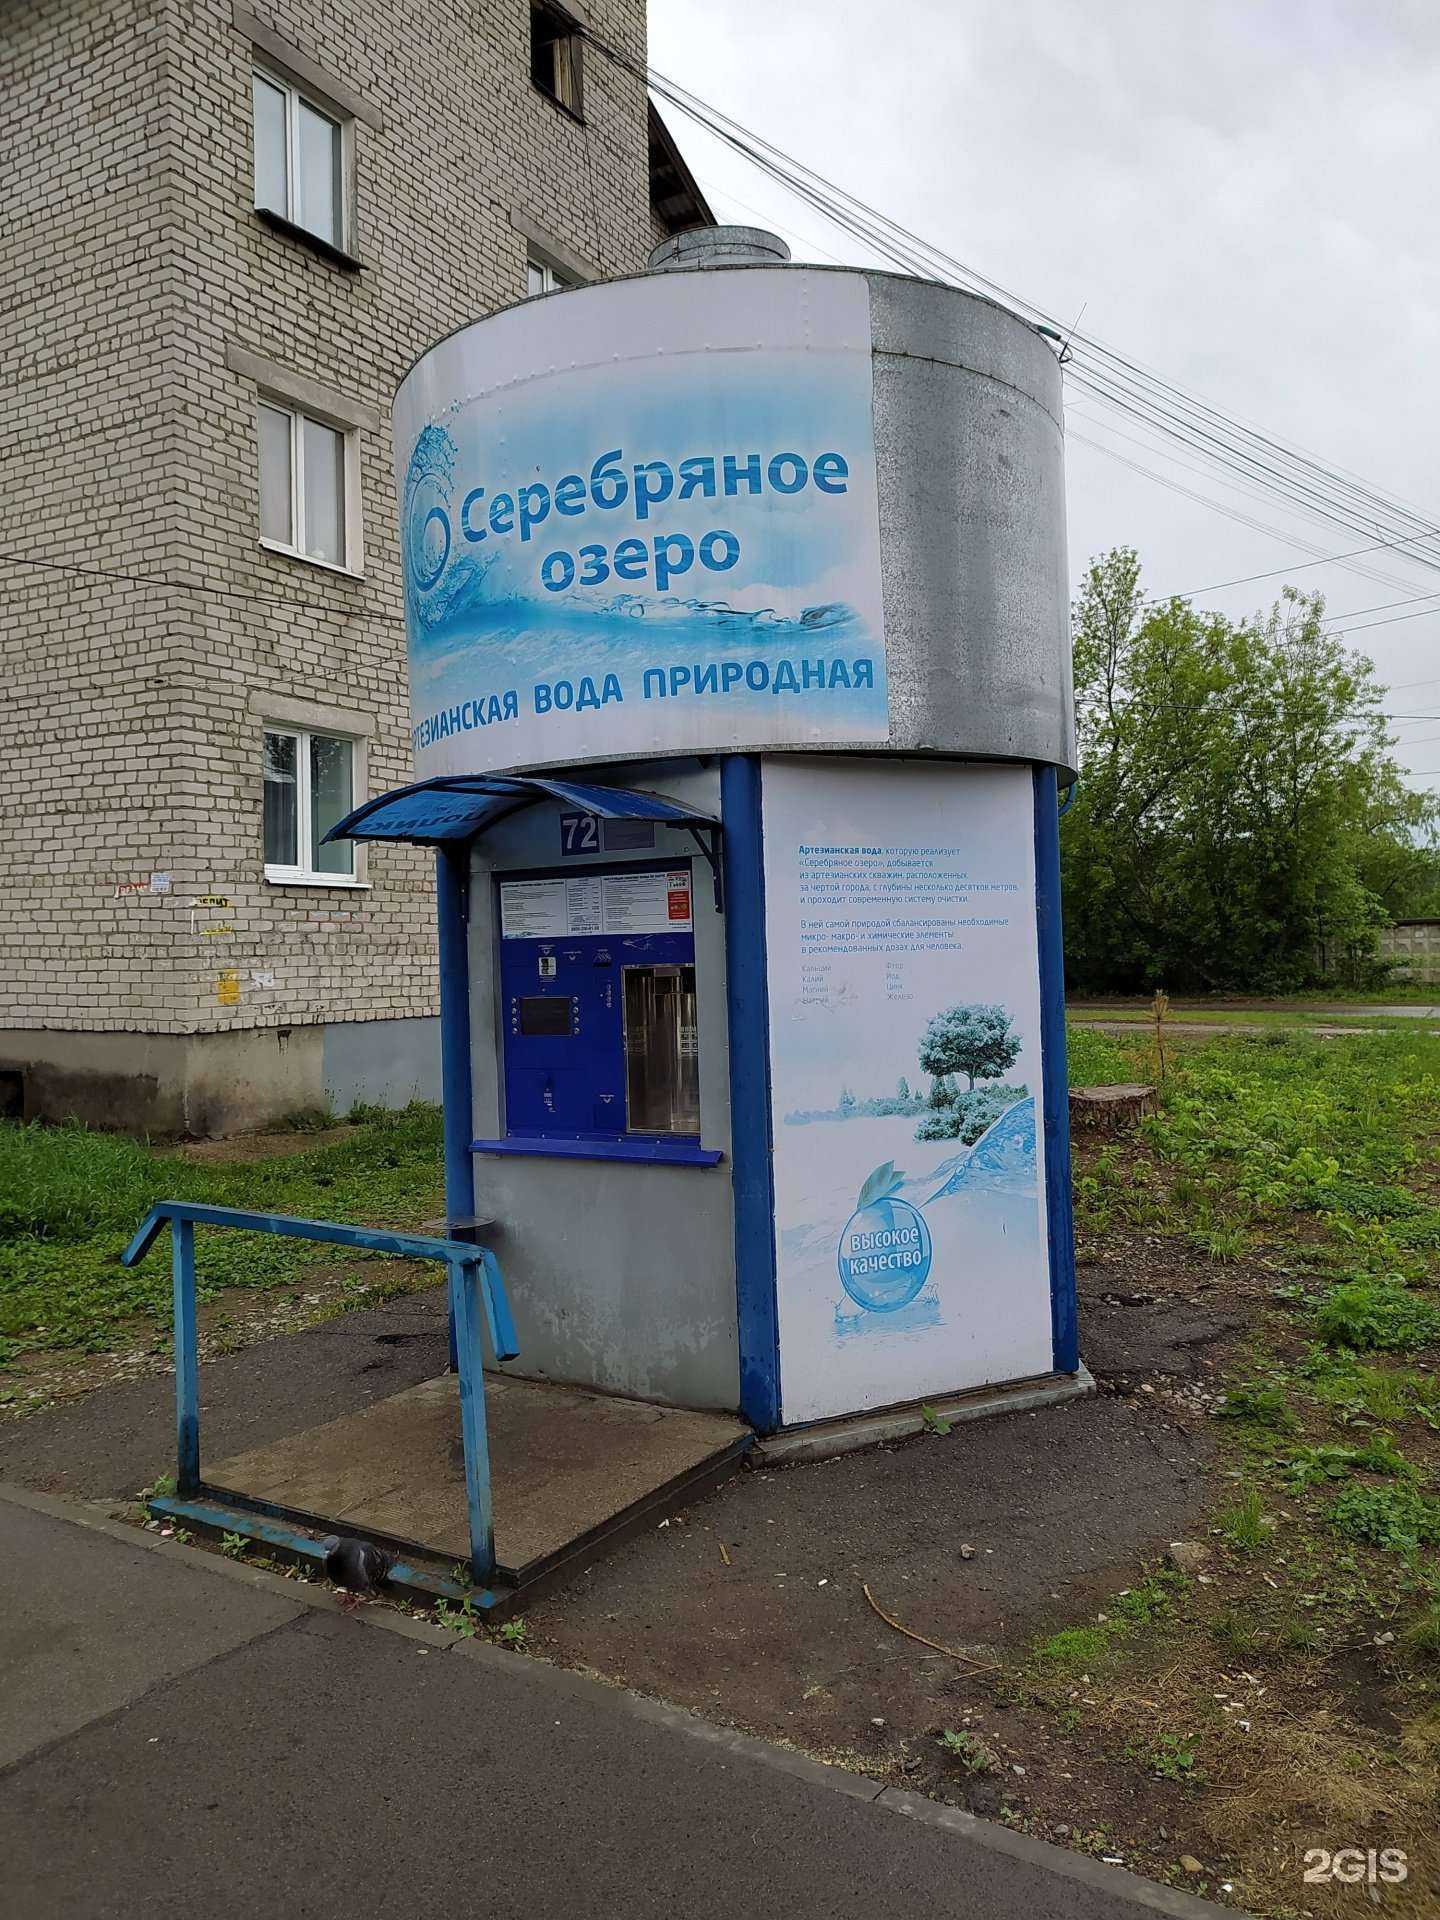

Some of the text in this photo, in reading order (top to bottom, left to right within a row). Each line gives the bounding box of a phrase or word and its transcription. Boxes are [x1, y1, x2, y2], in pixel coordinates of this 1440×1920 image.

[461, 449, 849, 542] Серебряное
[541, 529, 741, 592] озеро
[533, 673, 623, 714] ВОДА
[643, 658, 874, 699] ПРИРОДНАЯ
[562, 816, 597, 849] 72
[799, 846, 860, 856] Артезианская
[886, 847, 919, 857] которую
[920, 847, 961, 857] реализует
[807, 896, 846, 905] проходит
[848, 894, 903, 905] современную
[904, 894, 936, 905] систему
[800, 917, 1009, 929] В ней самой природой сбалансированы необходимые
[868, 930, 914, 940] химические
[808, 943, 883, 954] рекомендованных
[885, 943, 908, 953] дозах
[910, 942, 925, 952] для
